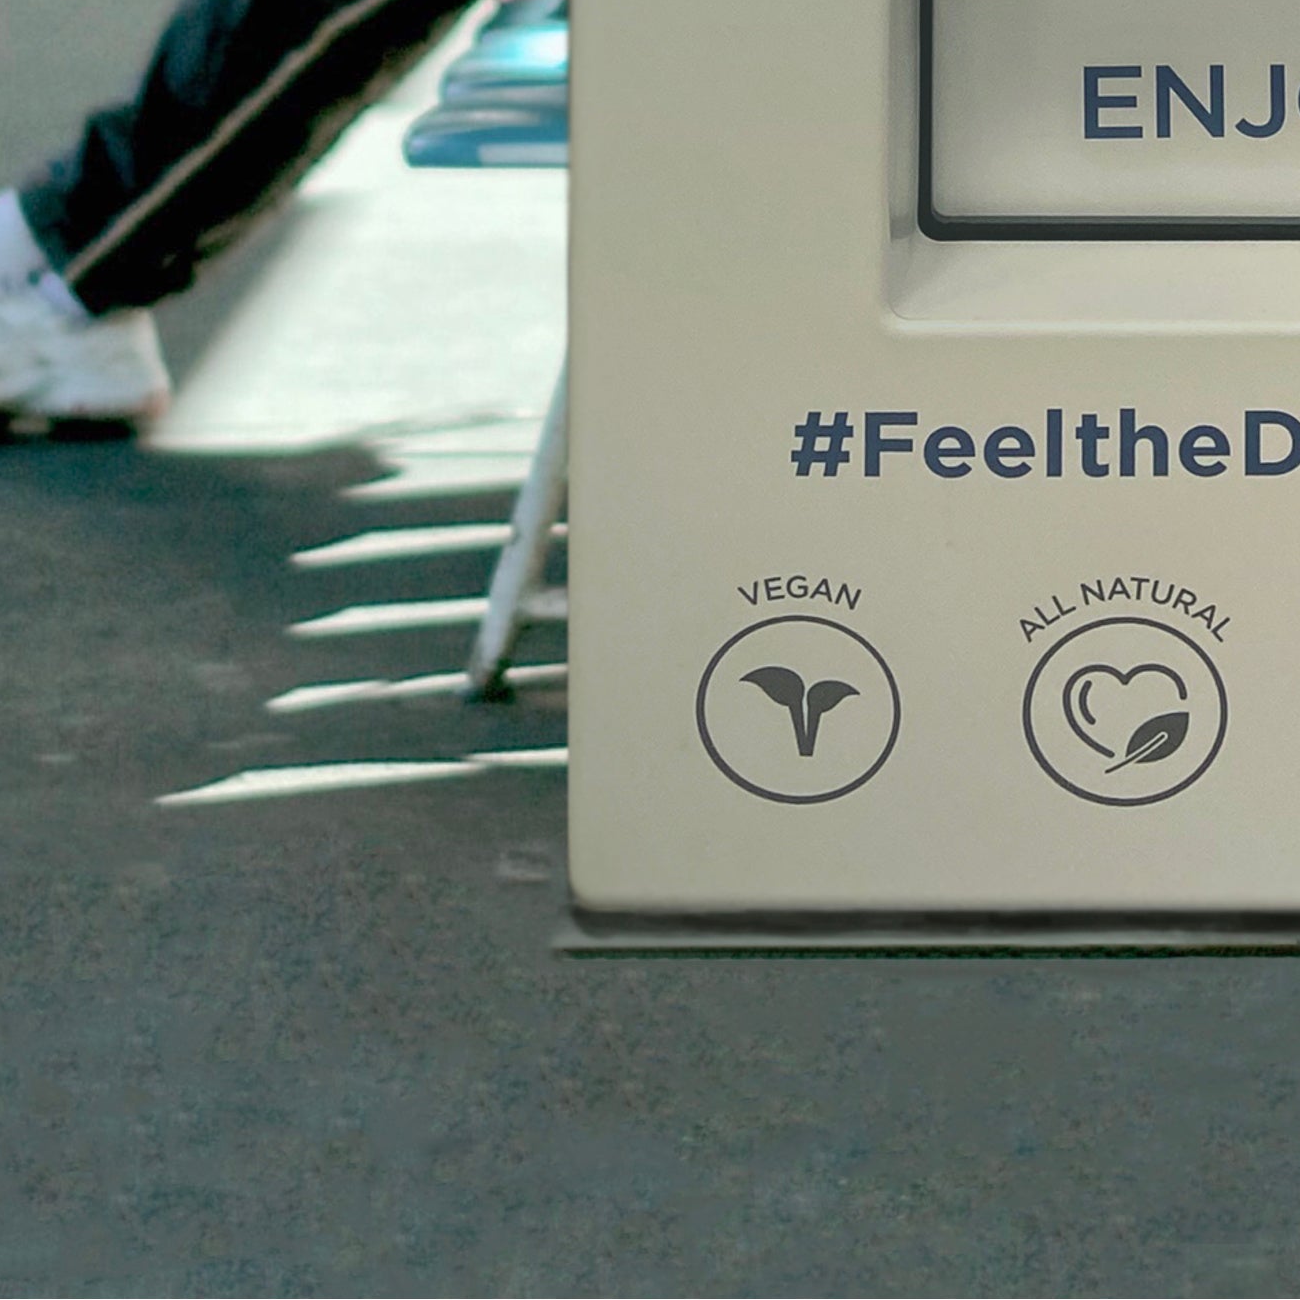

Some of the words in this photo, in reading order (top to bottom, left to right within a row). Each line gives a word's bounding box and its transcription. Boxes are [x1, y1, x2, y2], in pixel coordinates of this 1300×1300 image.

[737, 575, 861, 610] VEGAN
[1018, 595, 1077, 642] ALL
[1080, 576, 1231, 642] NATURAL
